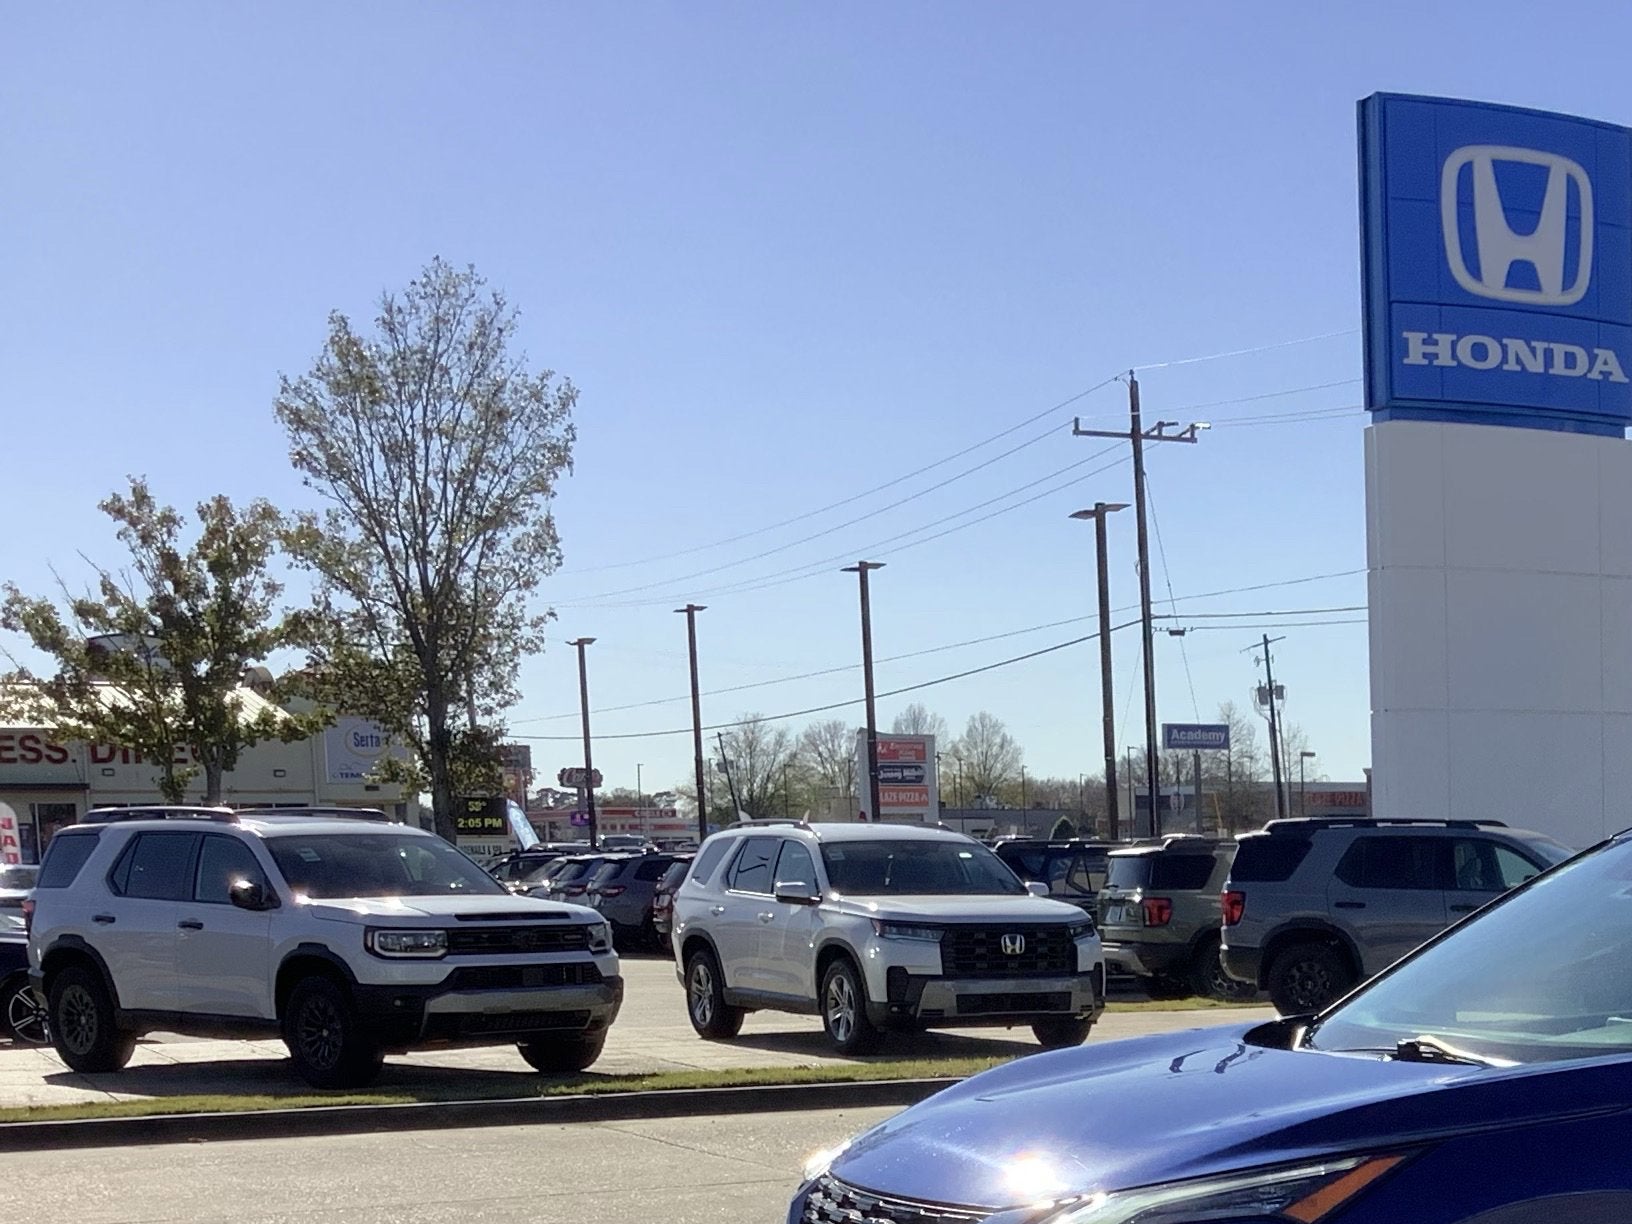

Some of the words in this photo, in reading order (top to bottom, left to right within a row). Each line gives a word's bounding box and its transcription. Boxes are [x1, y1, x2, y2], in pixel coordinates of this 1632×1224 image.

[1401, 331, 1630, 383] HONDA
[353, 731, 381, 748] Serta
[1171, 728, 1226, 744] Academy
[457, 817, 482, 828] 2:05
[484, 817, 503, 828] PM
